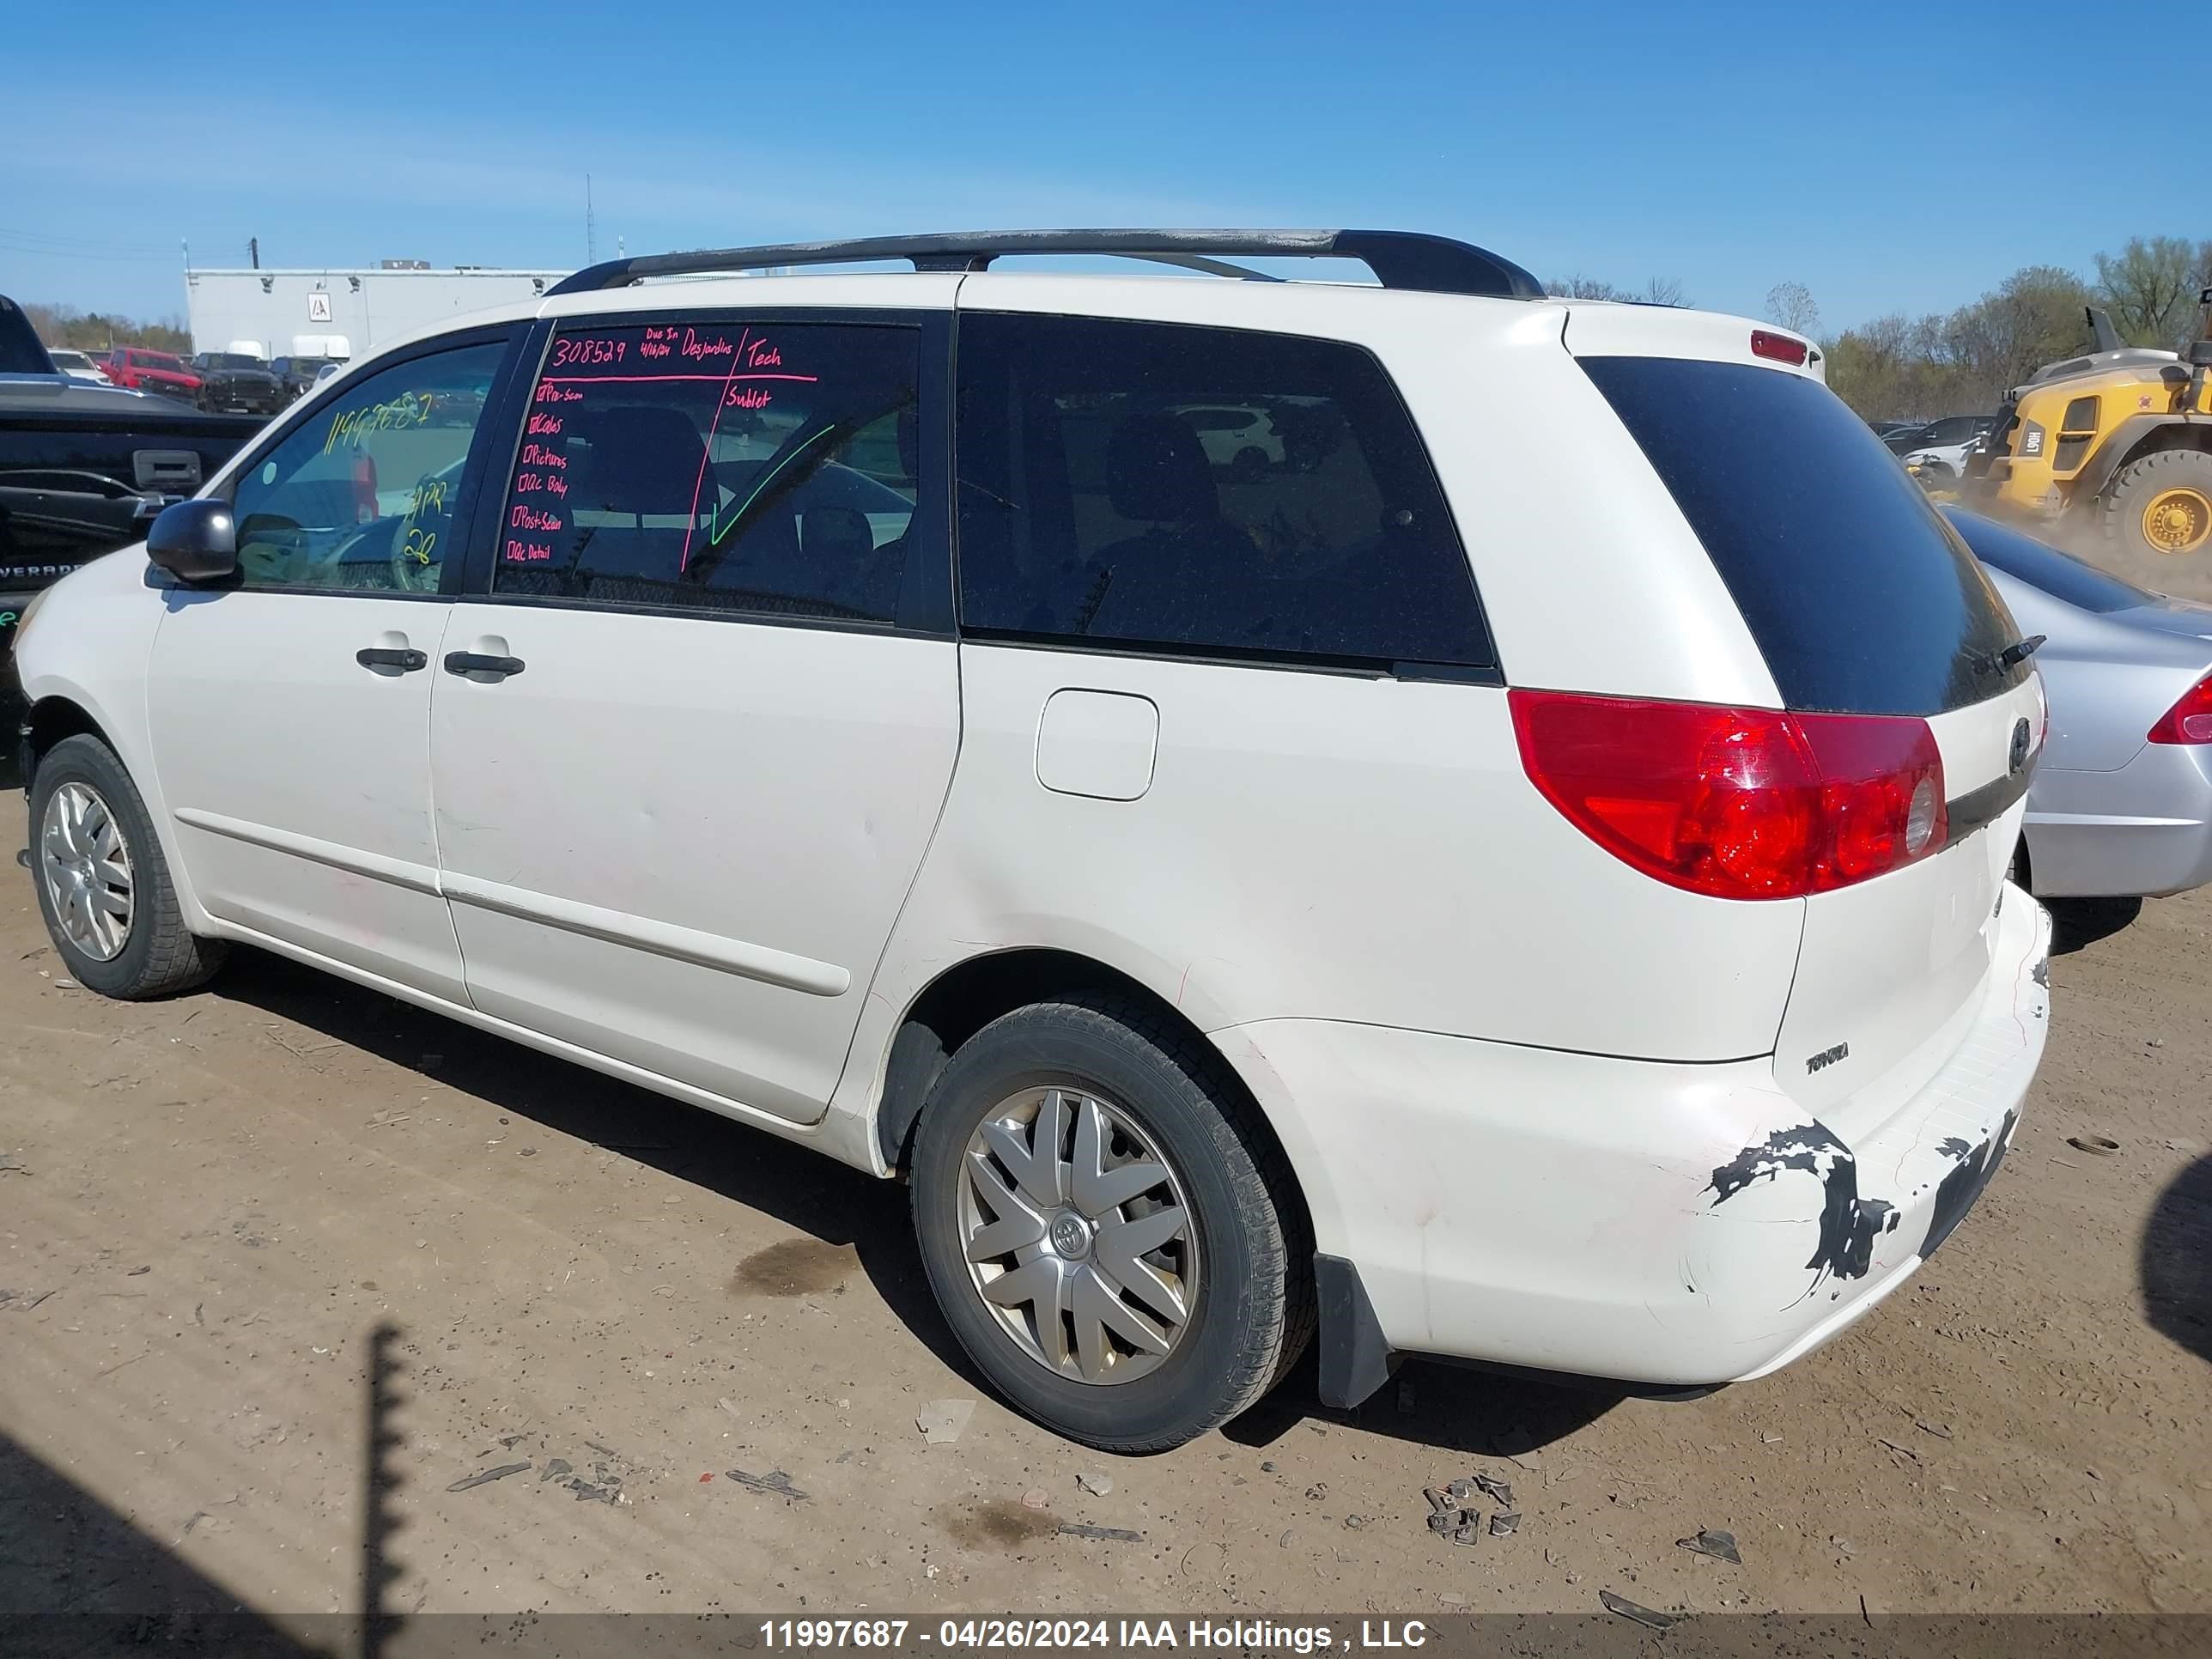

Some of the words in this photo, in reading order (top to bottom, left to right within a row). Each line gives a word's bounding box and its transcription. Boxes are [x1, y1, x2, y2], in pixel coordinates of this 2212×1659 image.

[646, 327, 663, 340] Due
[666, 326, 678, 341] In
[681, 328, 733, 361] Desjardins
[552, 339, 626, 367] 308529
[747, 338, 782, 368] Tech
[726, 386, 773, 409] Sublet
[2027, 432, 2041, 453] L90H
[528, 544, 550, 560] Detail
